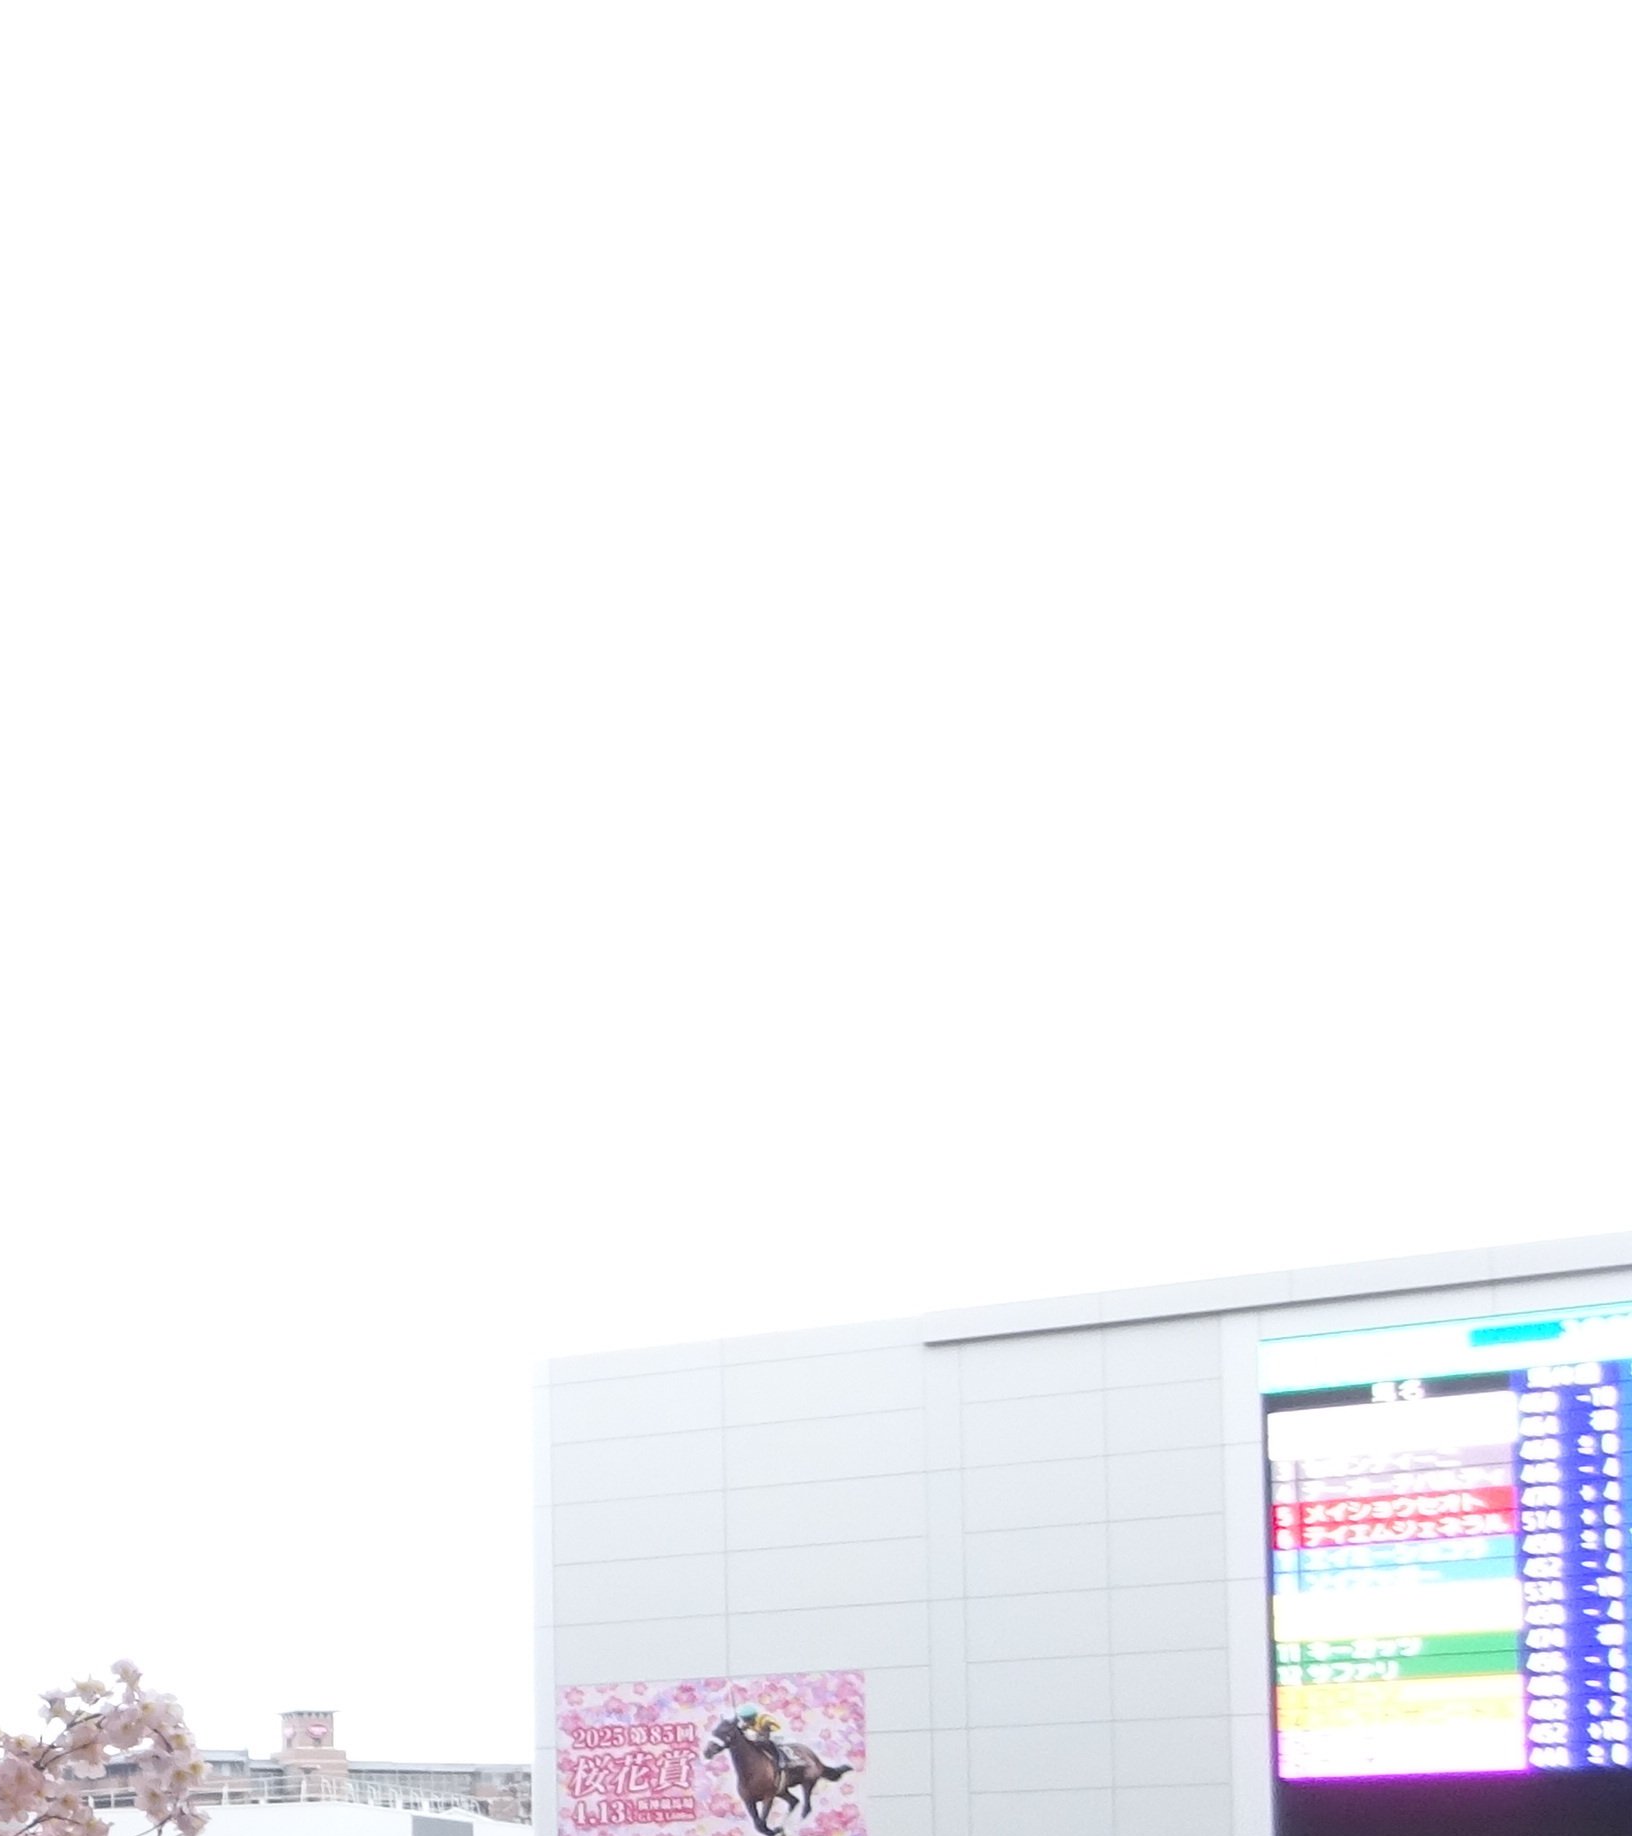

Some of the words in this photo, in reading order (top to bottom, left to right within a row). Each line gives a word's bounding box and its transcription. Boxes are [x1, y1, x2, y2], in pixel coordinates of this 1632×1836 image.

[572, 1727, 627, 1749] 2025
[570, 1749, 697, 1797] 桜花賞
